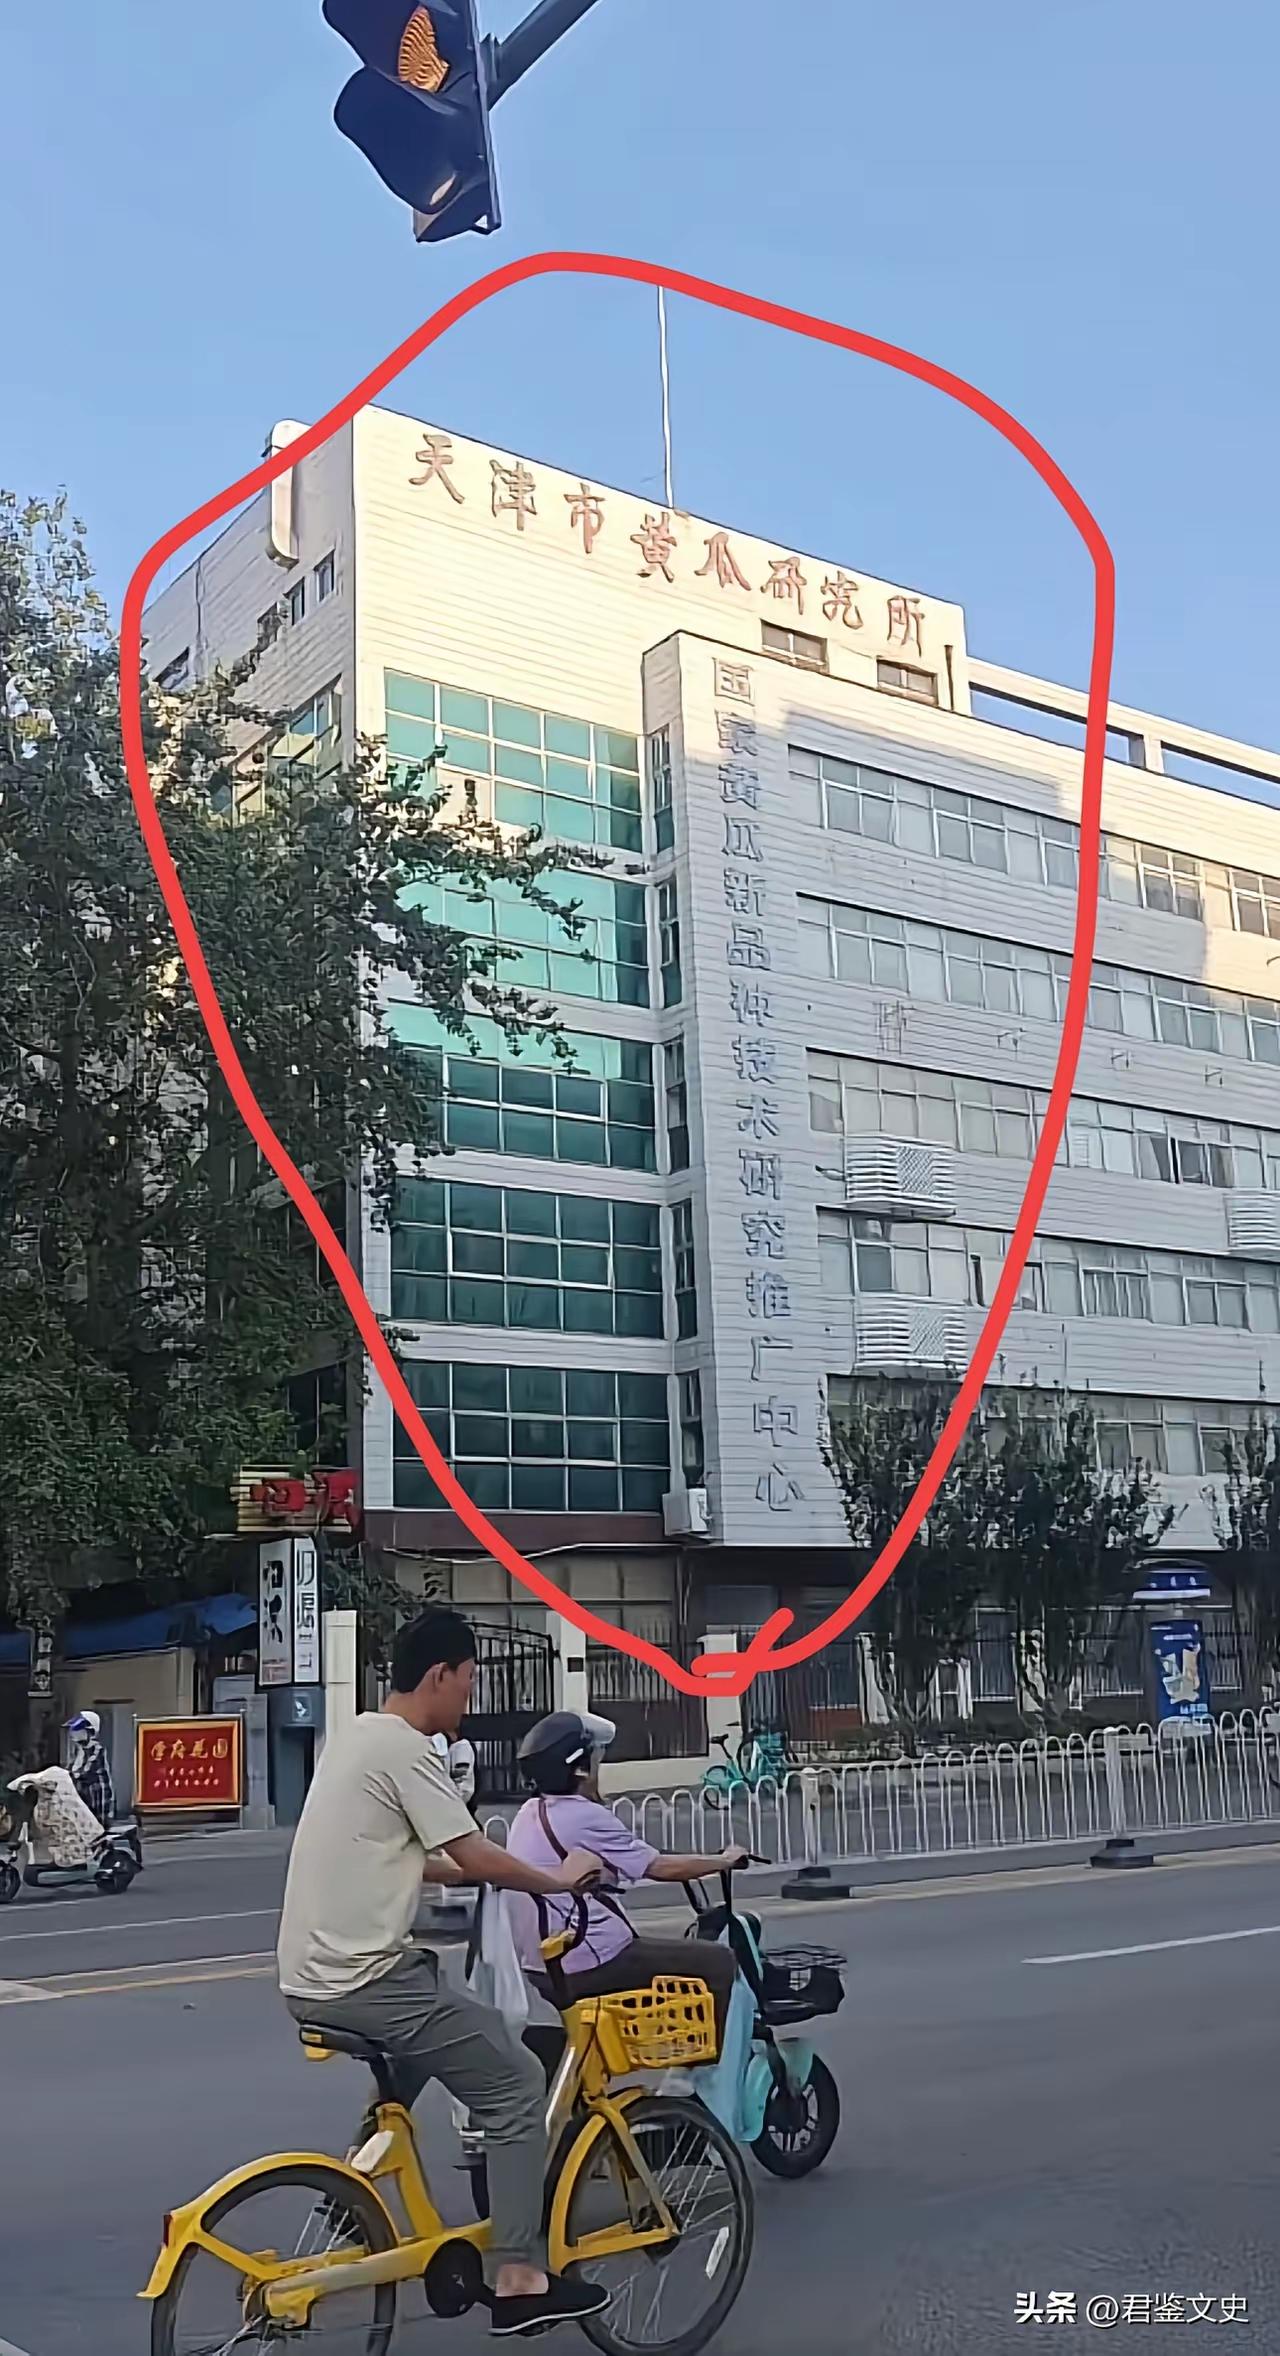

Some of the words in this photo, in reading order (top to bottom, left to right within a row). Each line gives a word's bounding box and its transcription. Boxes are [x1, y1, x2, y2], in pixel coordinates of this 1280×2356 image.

[409, 433, 925, 657] 天津市黄瓜研究所
[713, 657, 805, 1512] 国家黄瓜新品种技术研究推广中心
